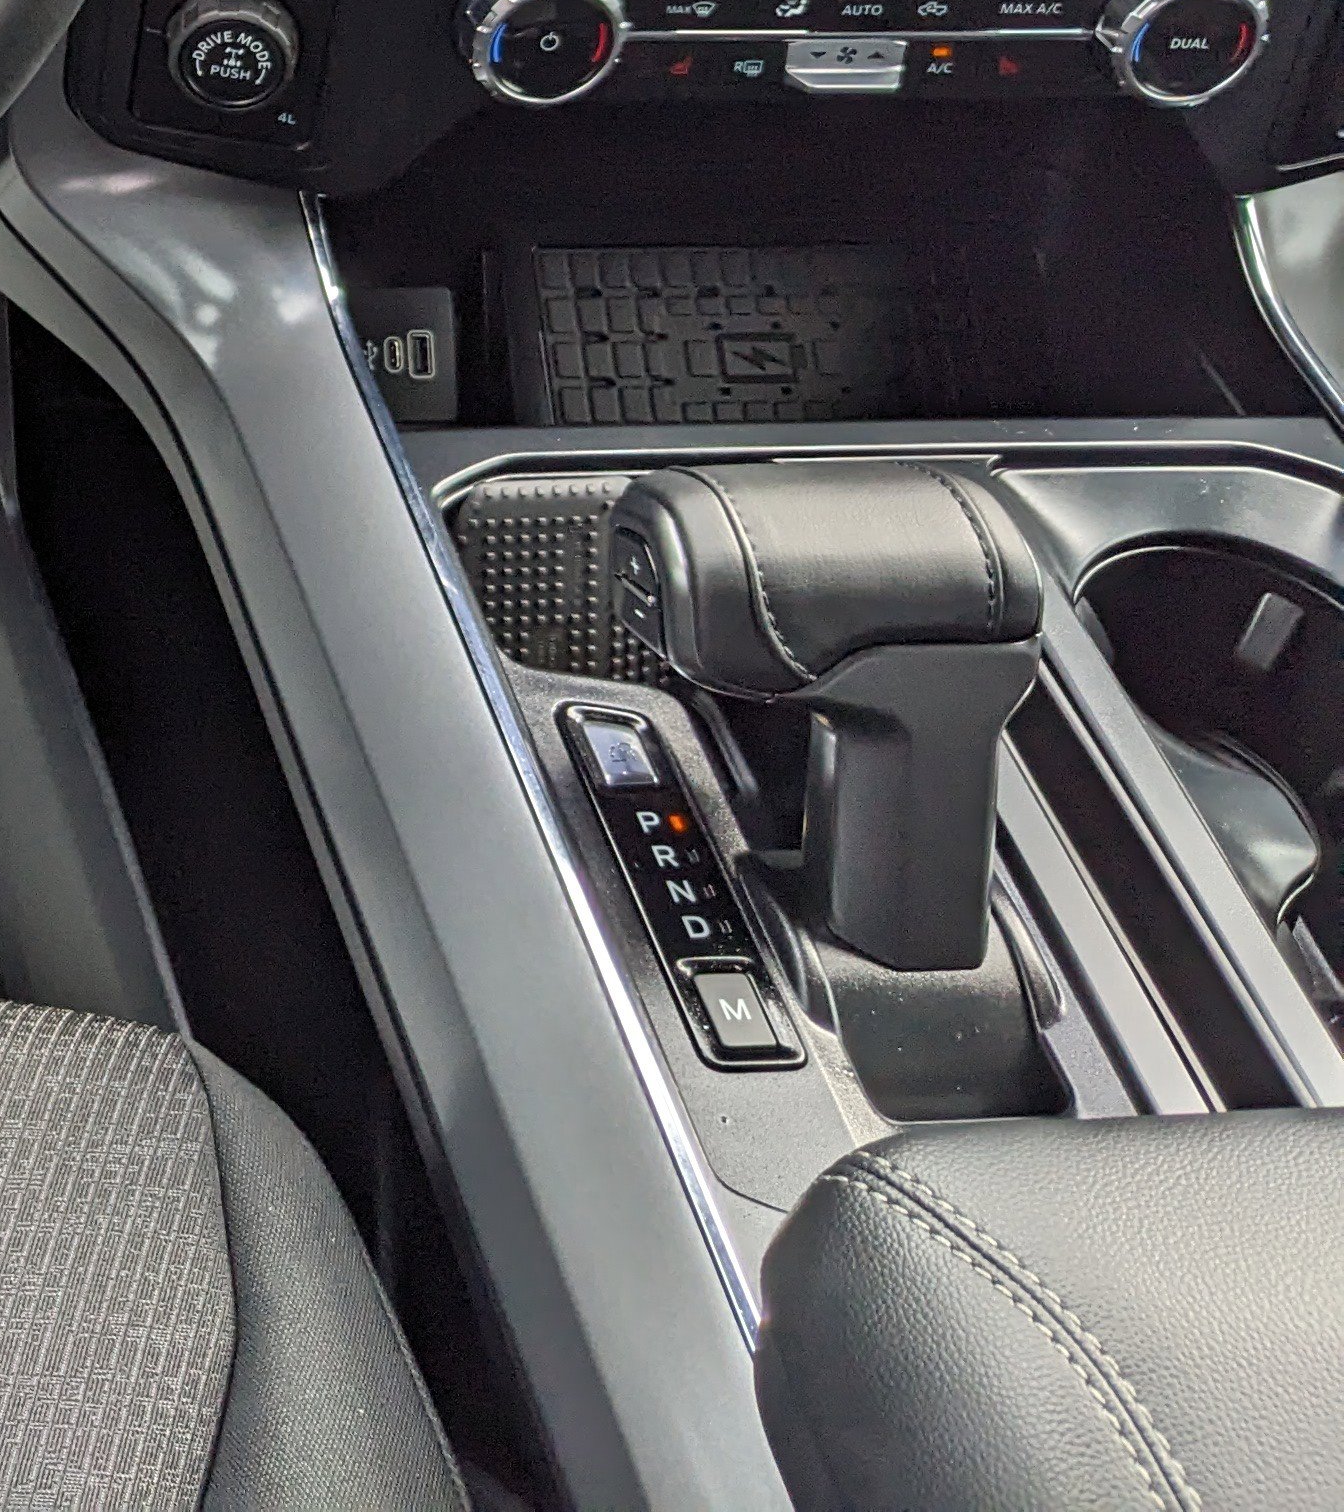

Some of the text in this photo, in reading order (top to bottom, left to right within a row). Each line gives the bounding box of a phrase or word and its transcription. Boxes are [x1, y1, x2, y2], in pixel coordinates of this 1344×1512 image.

[841, 4, 883, 17] AUTO
[1000, 2, 1064, 15] MAX A/C
[192, 30, 271, 70] DRIVE MODE
[1170, 37, 1210, 51] DUAL
[210, 65, 251, 81] PUSH
[927, 62, 953, 75] A/C
[277, 112, 296, 125] 4L
[635, 811, 659, 834] P
[651, 845, 680, 868] R
[666, 879, 697, 904] N
[682, 915, 711, 939] D
[720, 998, 751, 1021] M
